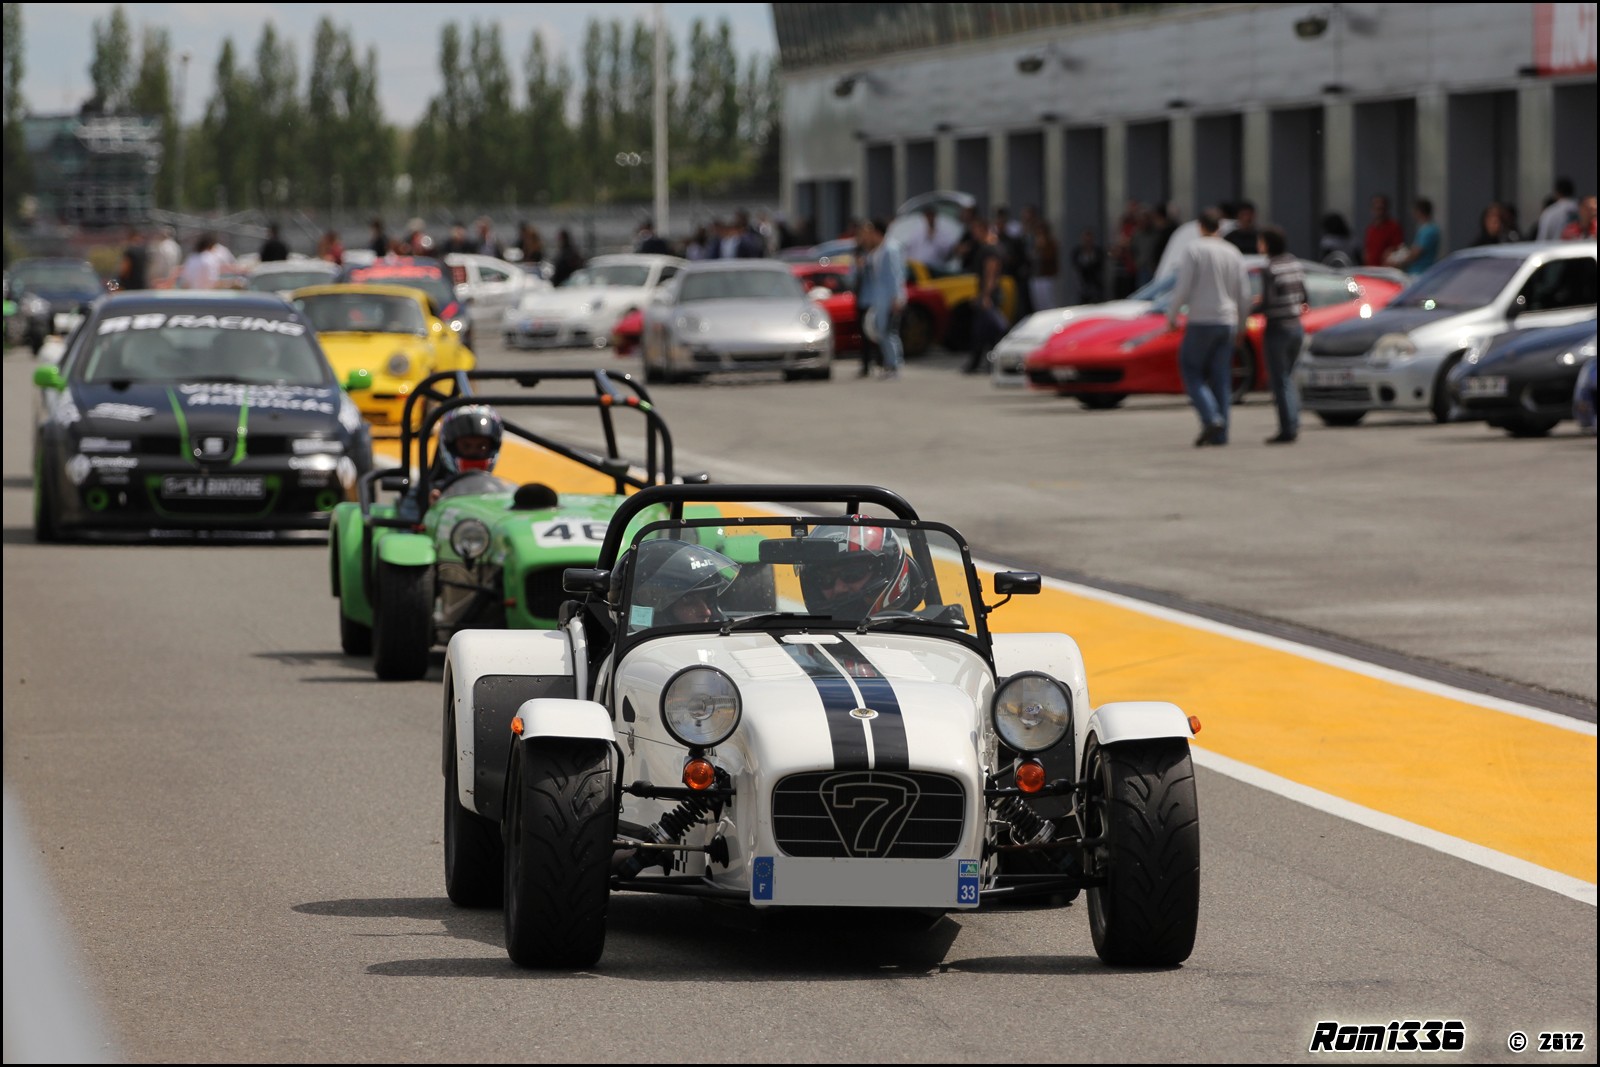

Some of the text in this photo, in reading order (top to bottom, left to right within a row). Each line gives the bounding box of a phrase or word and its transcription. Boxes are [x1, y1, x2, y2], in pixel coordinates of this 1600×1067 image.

[167, 314, 305, 336] RACING
[833, 782, 908, 852] 7
[759, 883, 766, 893] F
[961, 885, 976, 900] 33
